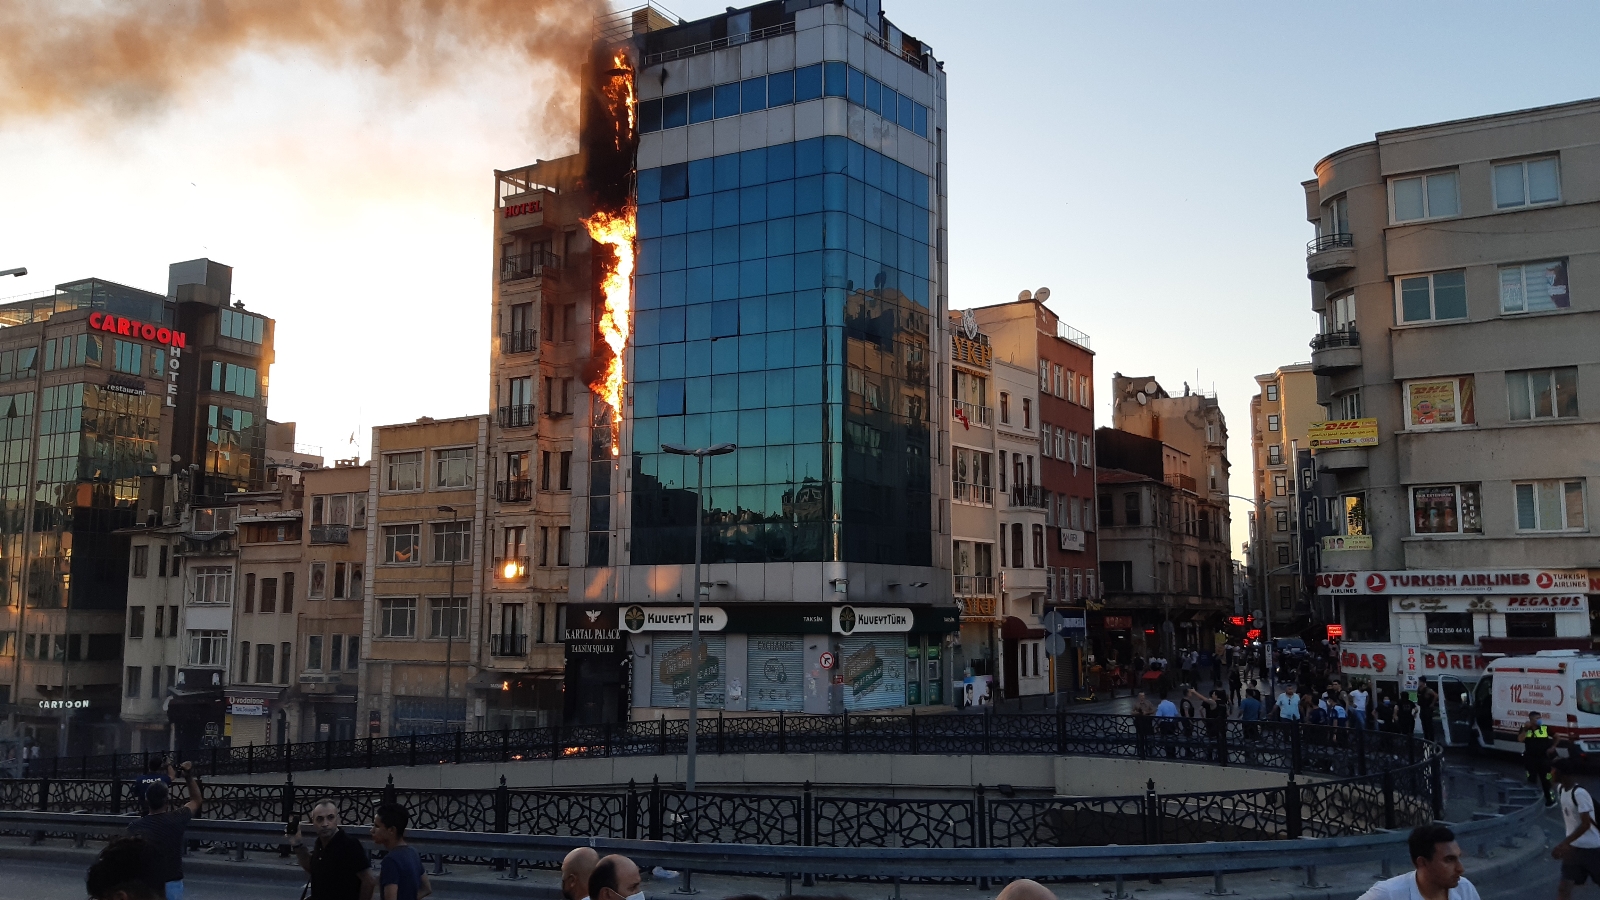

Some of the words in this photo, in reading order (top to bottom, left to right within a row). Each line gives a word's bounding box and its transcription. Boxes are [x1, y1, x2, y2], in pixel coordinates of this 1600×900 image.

[504, 200, 542, 218] HOTEL
[89, 311, 187, 348] CARTOON
[166, 346, 181, 408] HOTEL
[107, 384, 146, 396] restaurant
[1414, 385, 1449, 394] DHL
[1325, 421, 1361, 430] DHL
[1468, 492, 1476, 524] PERUK
[1390, 574, 1457, 587] TURKISH
[1461, 573, 1531, 586] AIRLINES
[1508, 597, 1580, 606] PEGASUS
[565, 629, 593, 640] KARTAL
[594, 628, 621, 640] PALACE
[1510, 683, 1522, 703] 112
[38, 699, 90, 709] CARTOON
[235, 697, 264, 705] vodafone
